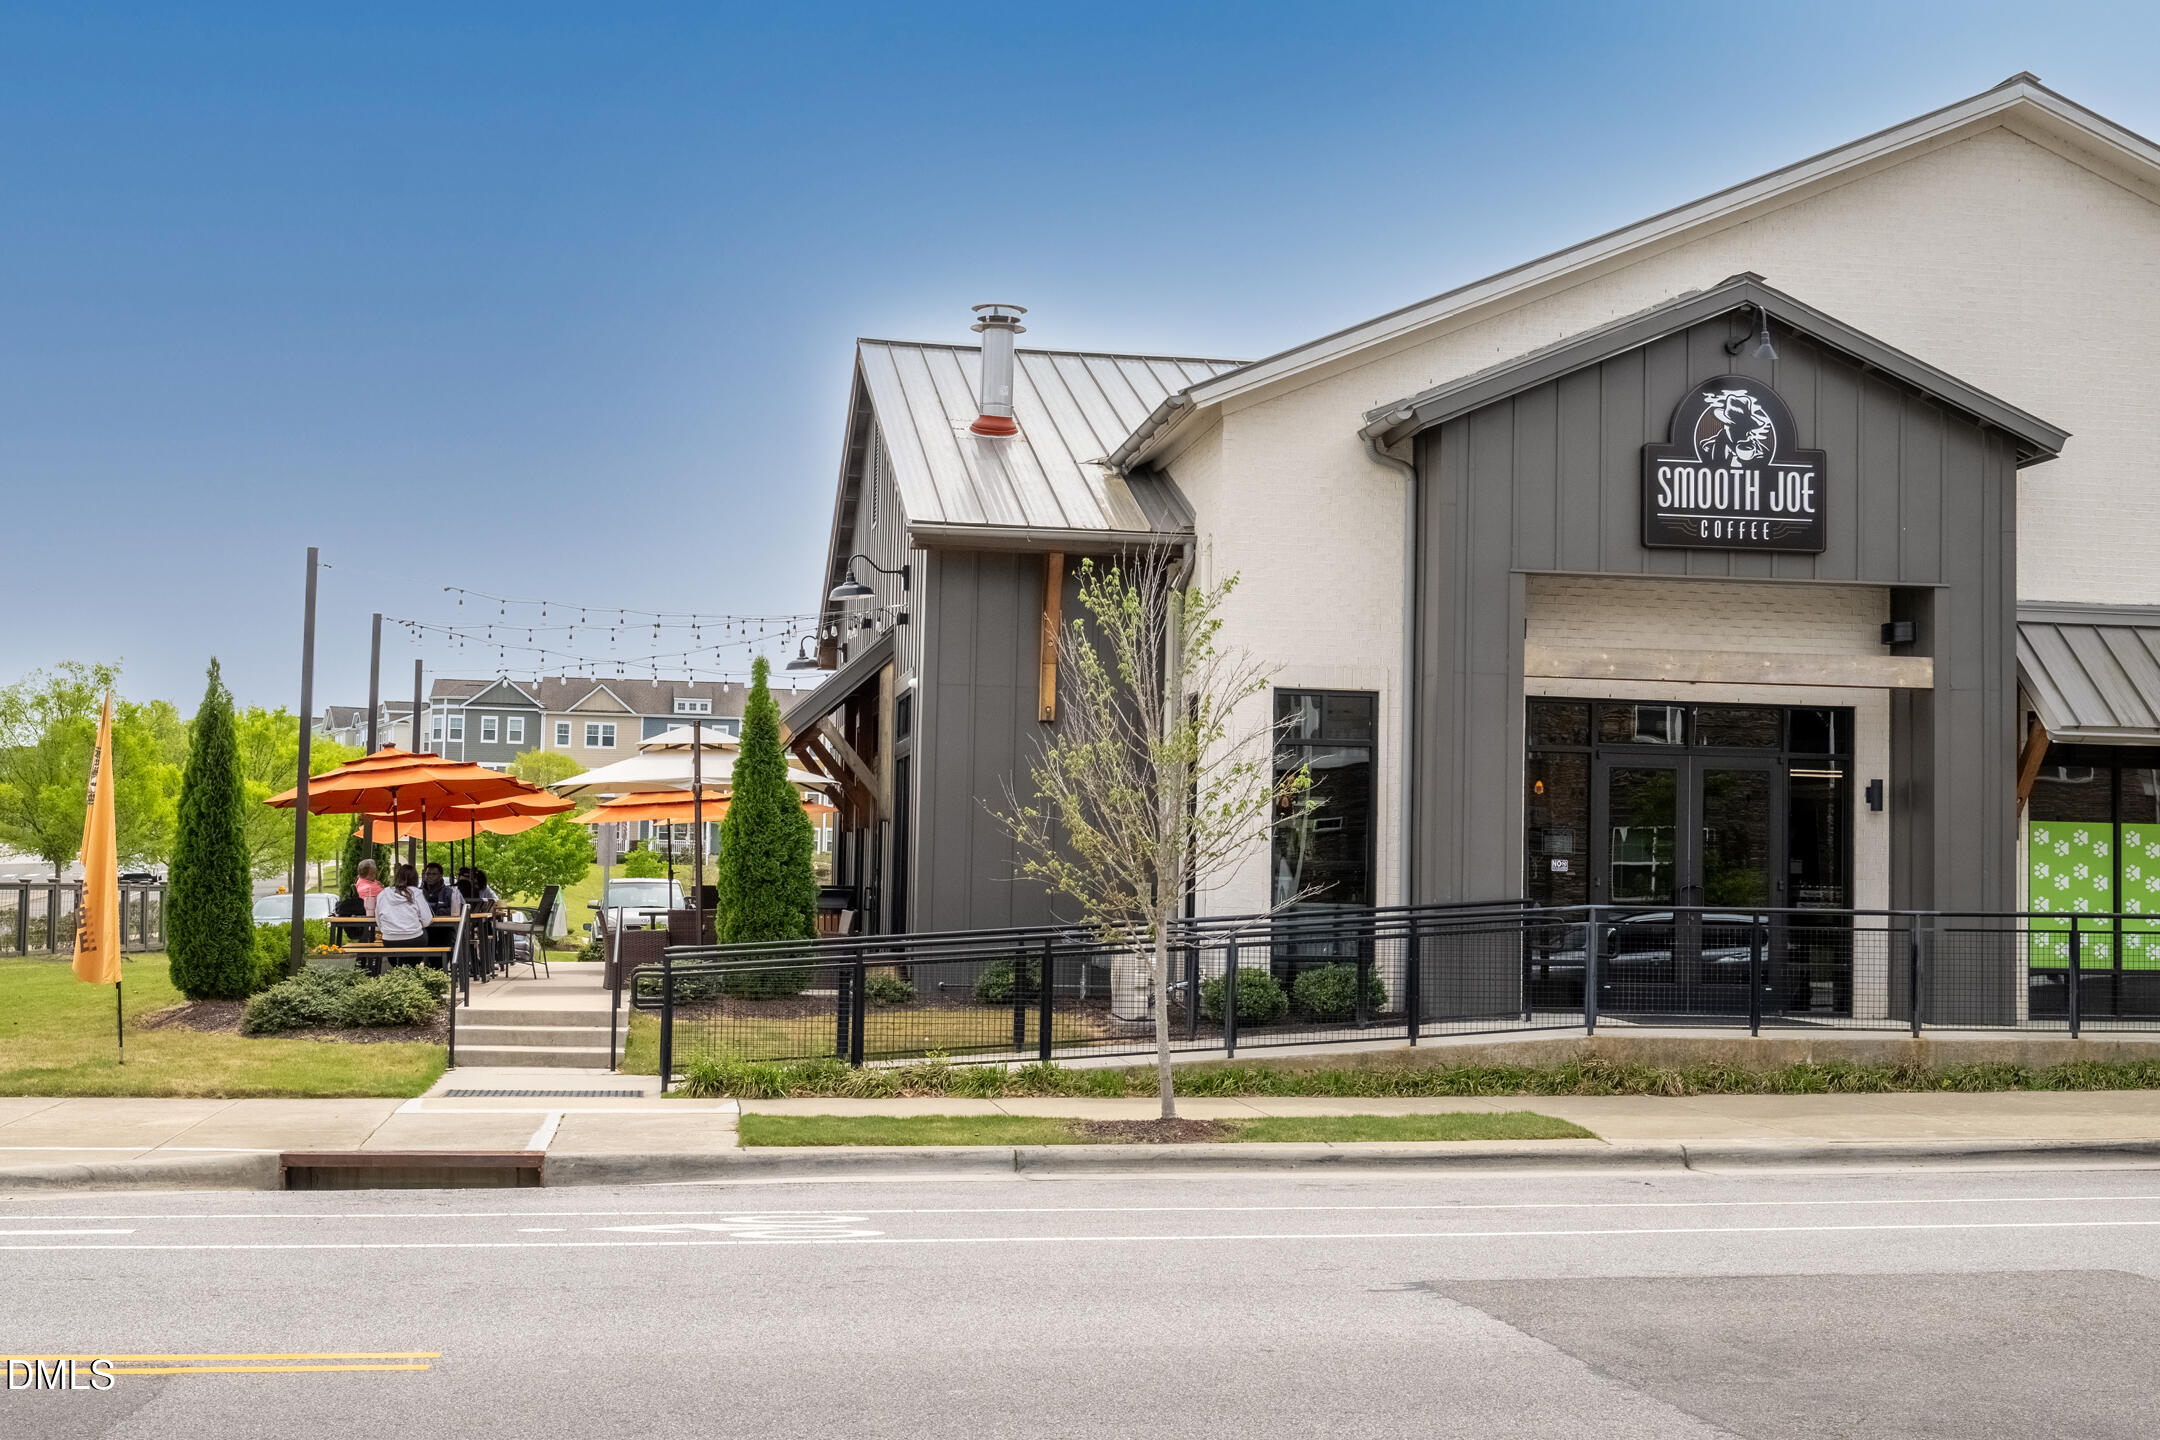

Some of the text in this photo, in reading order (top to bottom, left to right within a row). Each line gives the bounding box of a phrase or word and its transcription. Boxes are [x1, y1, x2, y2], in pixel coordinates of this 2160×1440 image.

[1657, 466, 1816, 513] SMOOTH JOE
[1701, 520, 1770, 540] COFFEE
